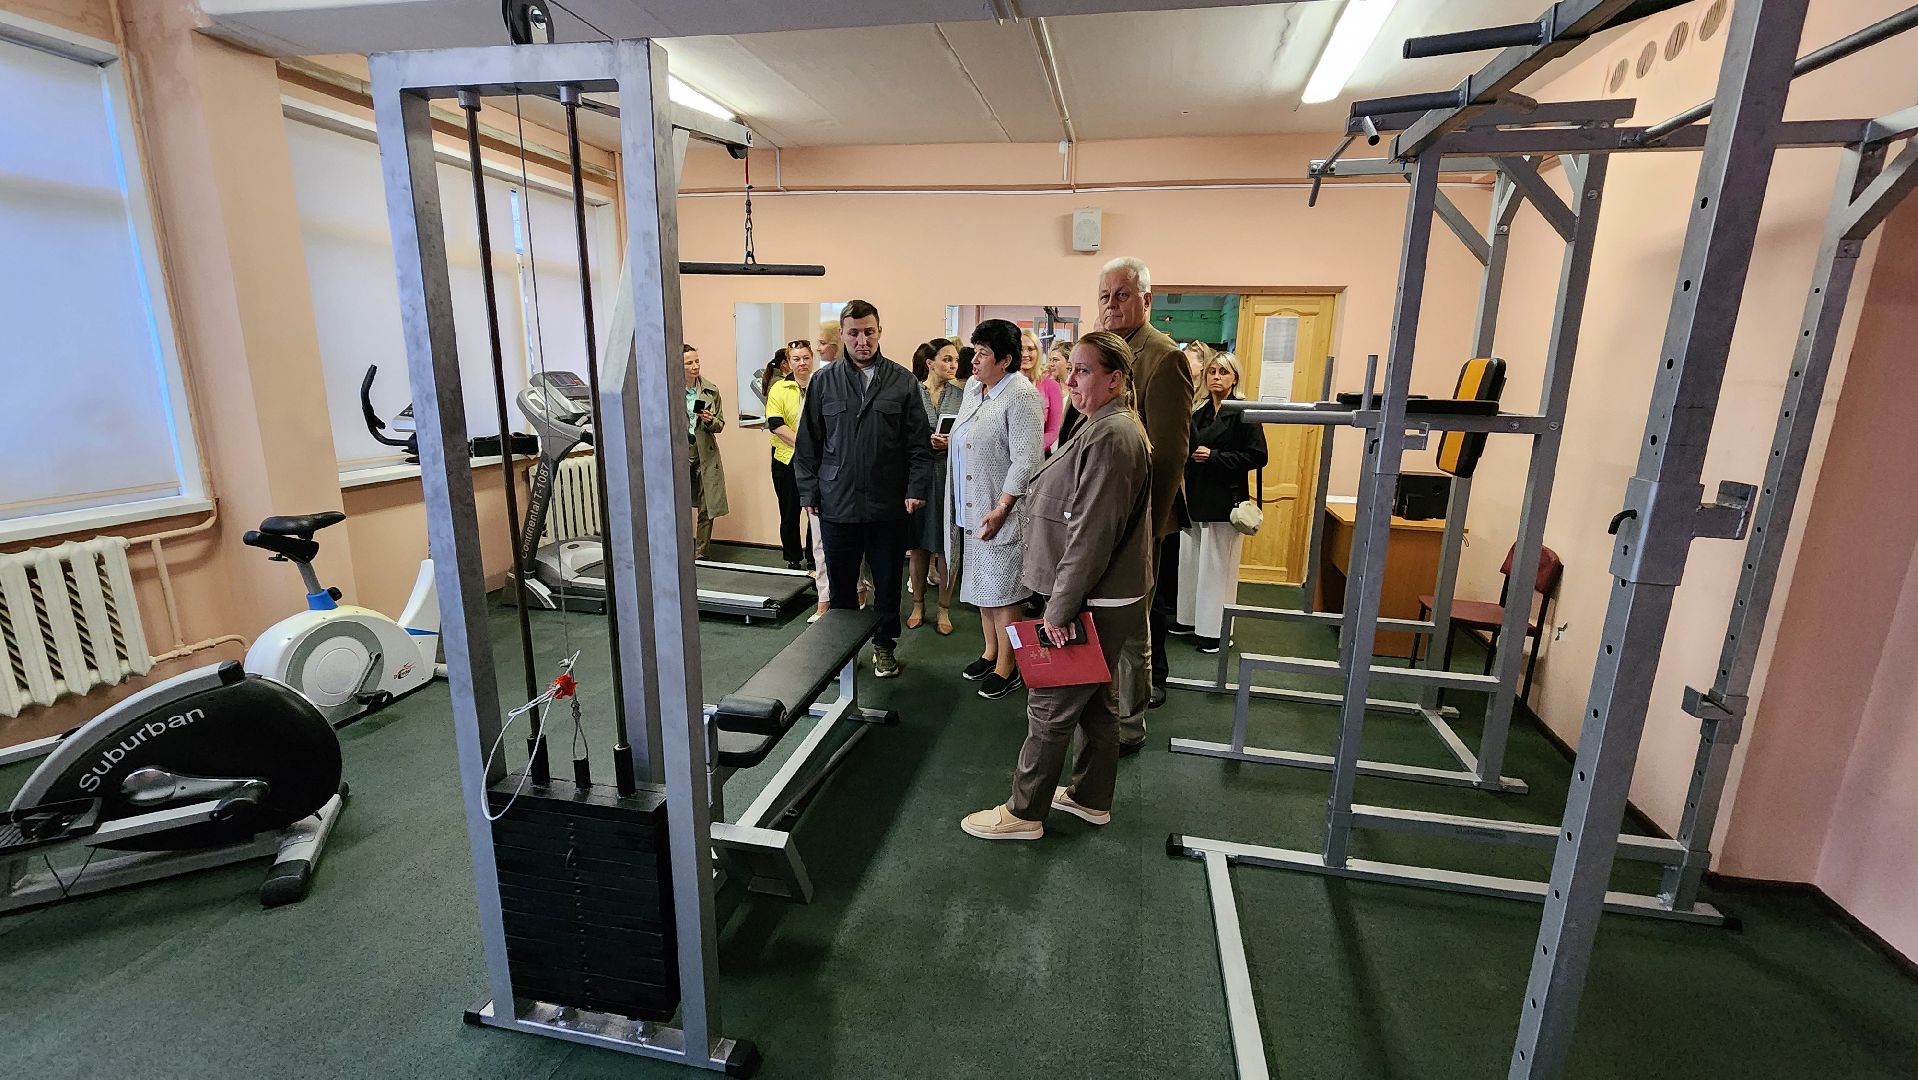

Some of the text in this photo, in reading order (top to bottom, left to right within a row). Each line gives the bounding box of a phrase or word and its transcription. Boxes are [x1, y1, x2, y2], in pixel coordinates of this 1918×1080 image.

[521, 462, 549, 560] Continental T-1087
[79, 708, 205, 793] Suburban
